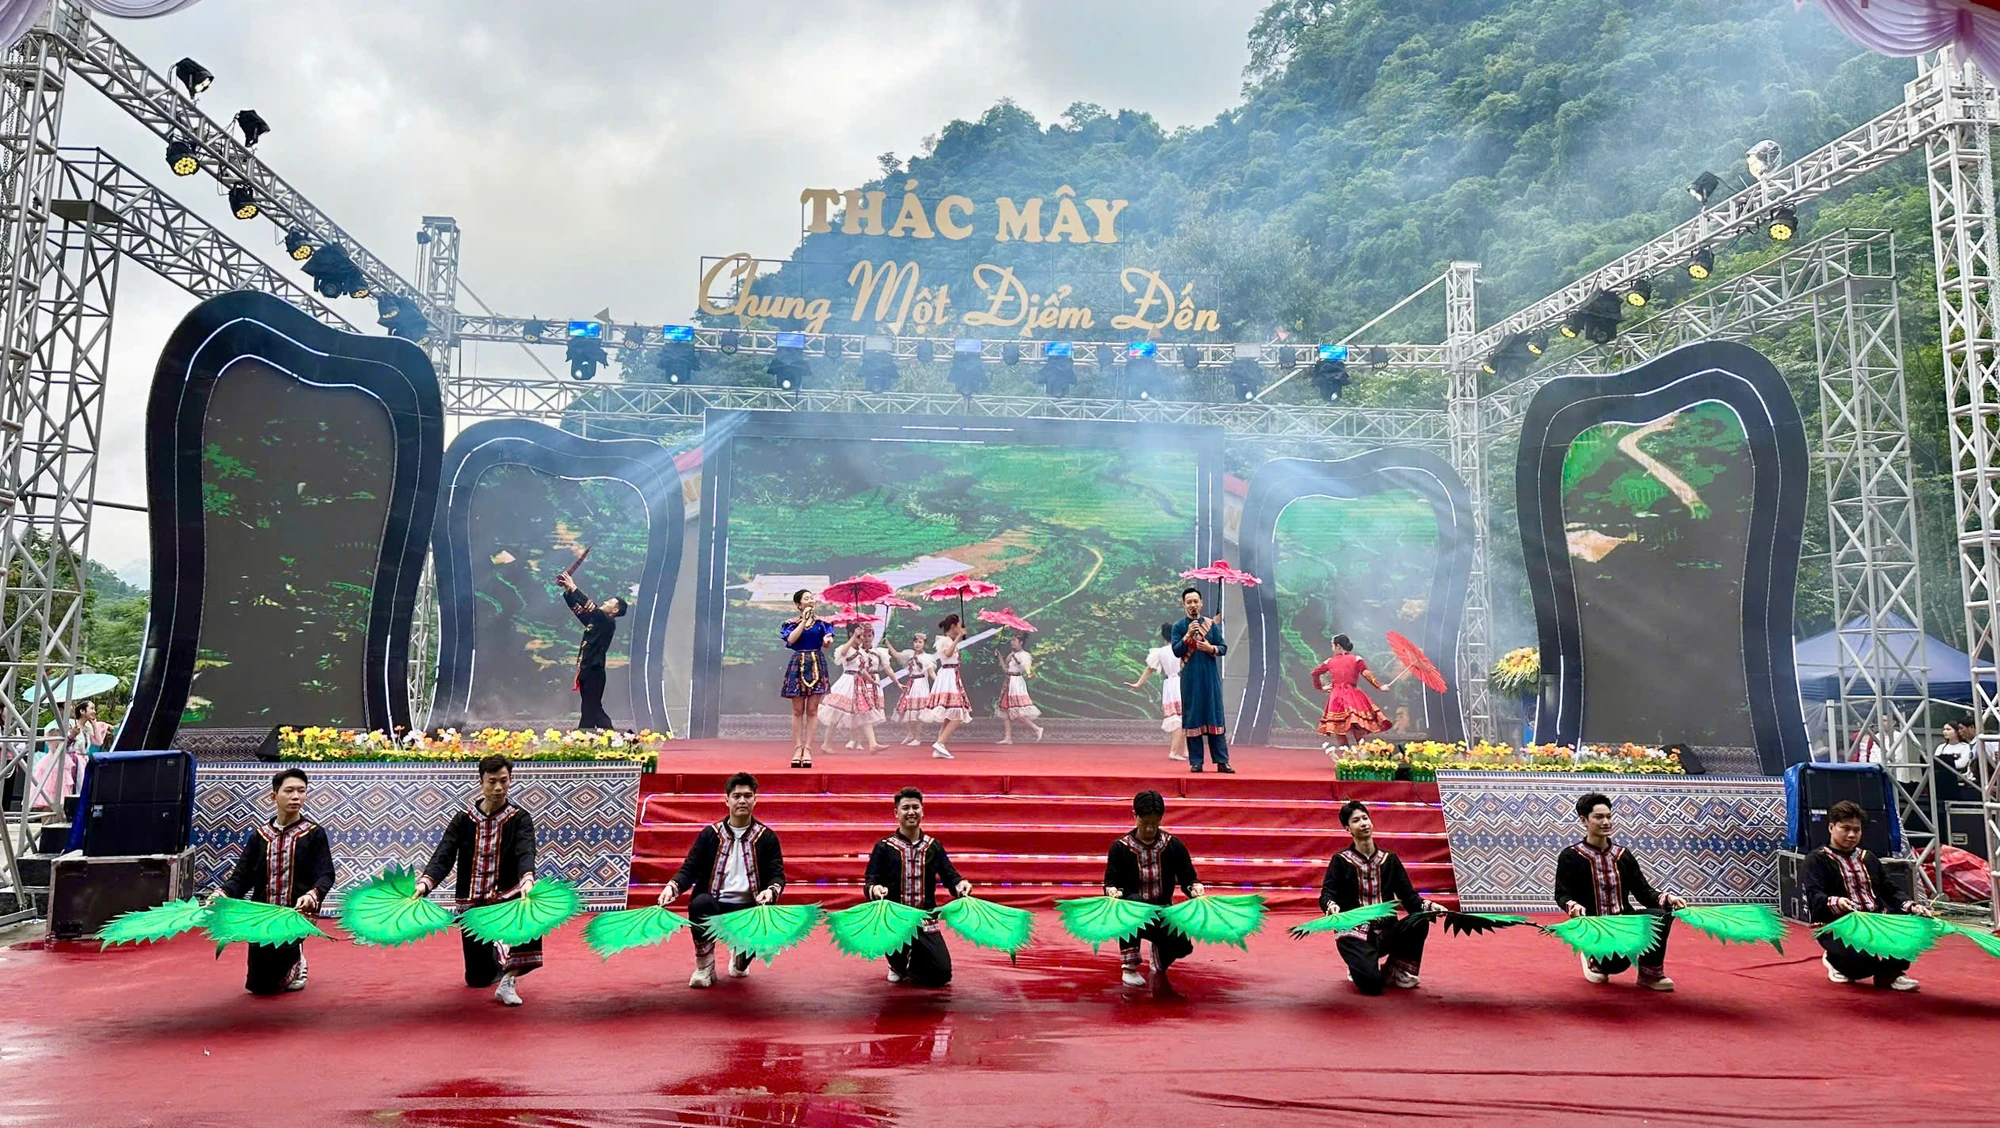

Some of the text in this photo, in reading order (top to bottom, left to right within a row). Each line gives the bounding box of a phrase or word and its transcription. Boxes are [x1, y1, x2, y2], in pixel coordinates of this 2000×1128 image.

[800, 180, 1129, 243] THÁC MÂY
[698, 252, 1220, 335] Chung Một Điểm Đến
